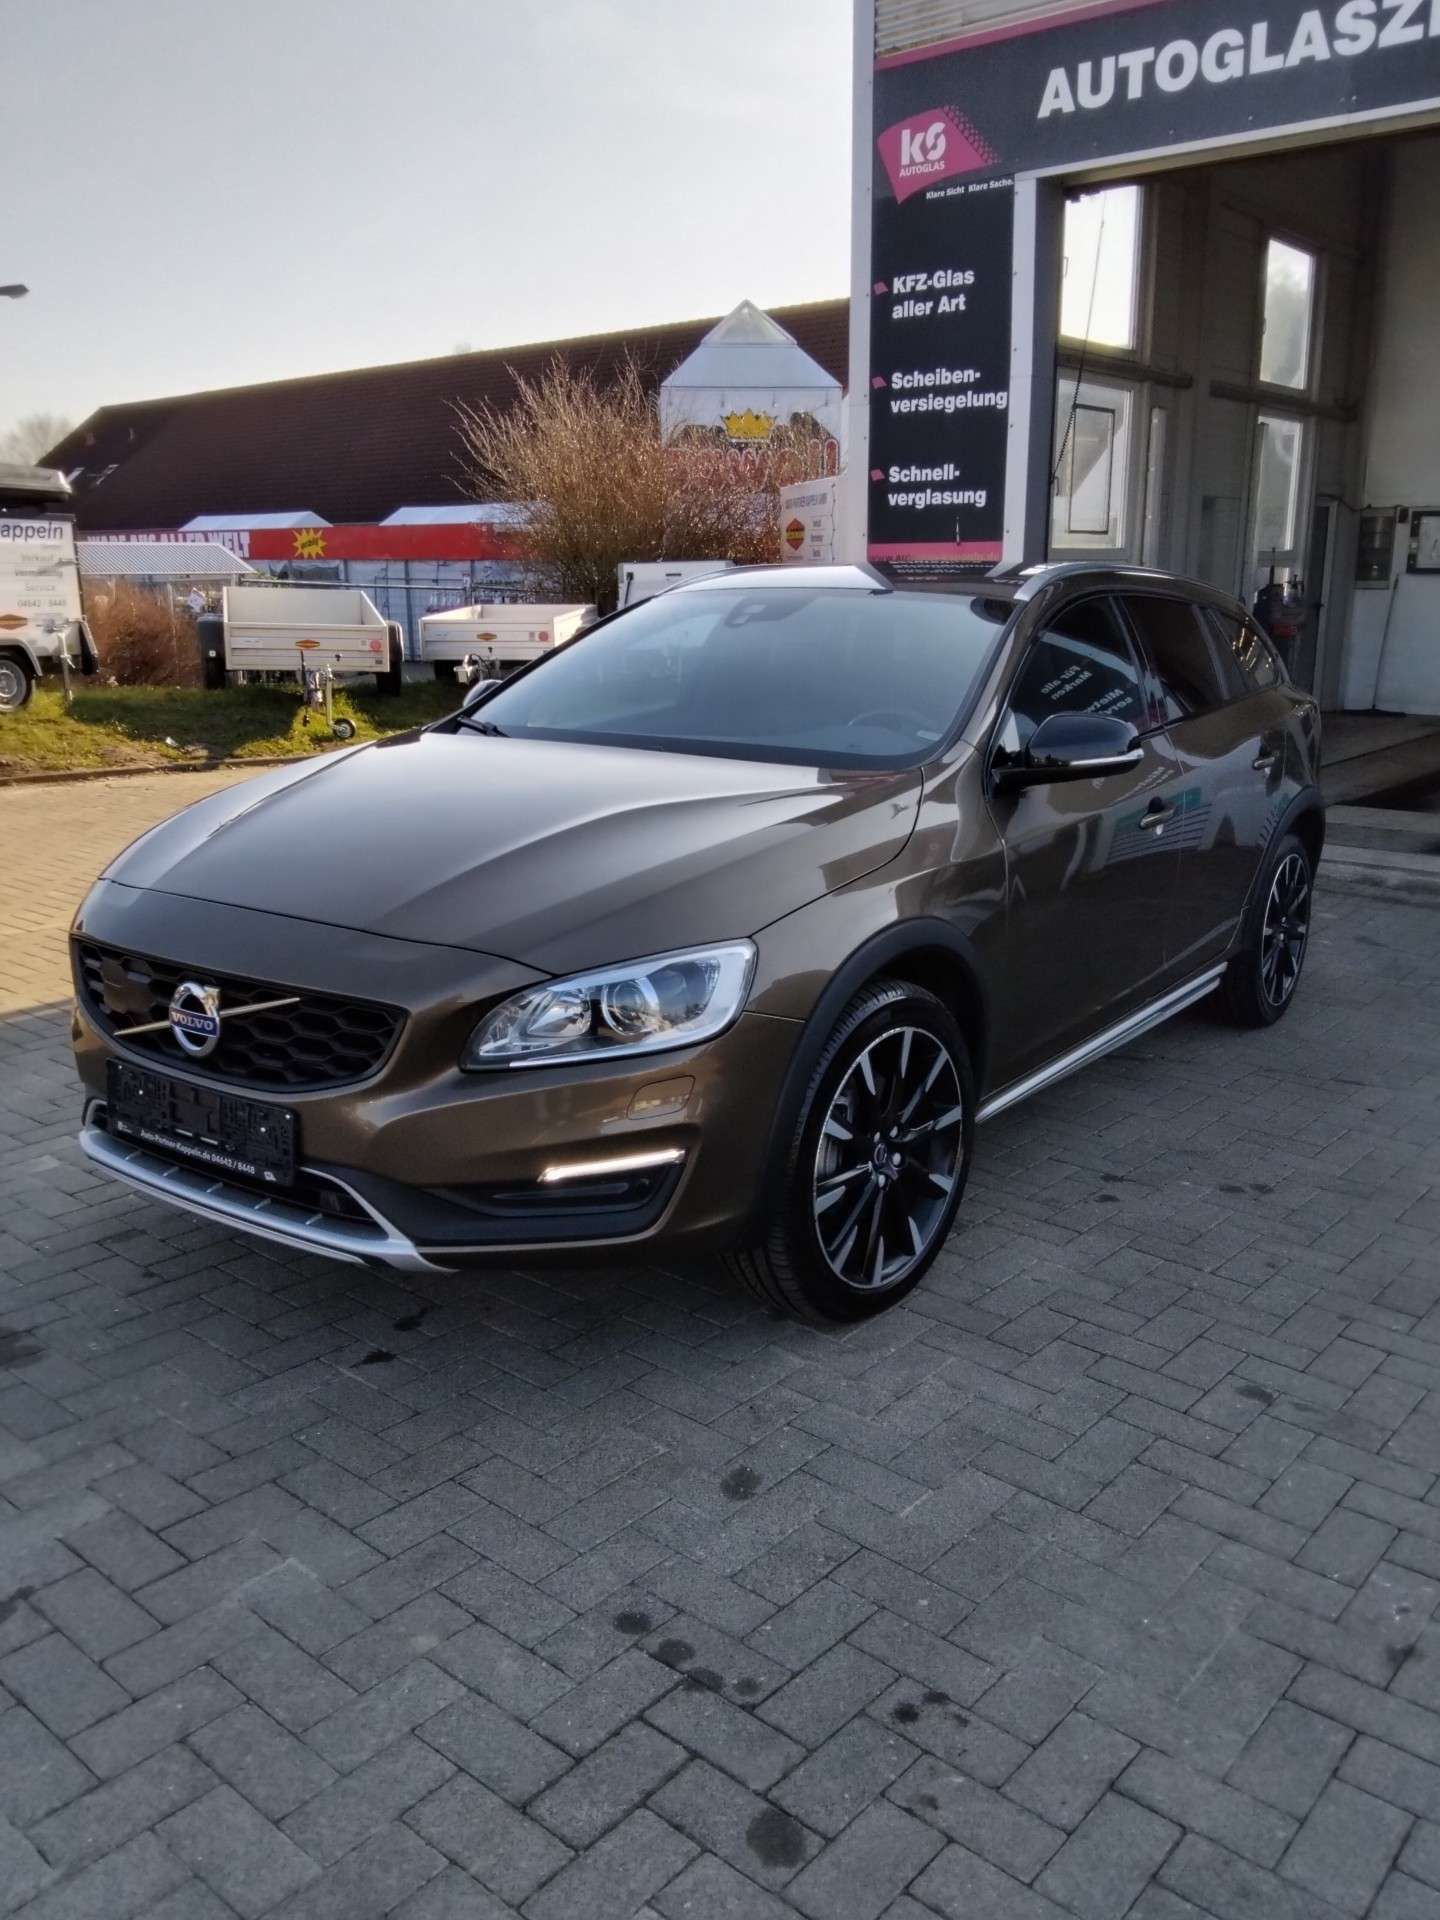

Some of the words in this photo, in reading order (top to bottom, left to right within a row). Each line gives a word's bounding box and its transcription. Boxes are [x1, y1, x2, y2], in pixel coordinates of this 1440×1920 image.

[899, 160, 945, 177] AUTOGLAS
[926, 190, 946, 199] Klare
[946, 185, 965, 196] Sicht
[968, 182, 988, 192] Klare
[892, 269, 975, 295] KFZ-Glas
[891, 300, 934, 319] aller
[937, 293, 966, 313] Art
[891, 367, 981, 390] Scheiben-
[890, 390, 1008, 413] versiegelung
[888, 463, 960, 483] Schnell-
[887, 488, 987, 509] verglasung
[170, 1011, 214, 1031] VOLVO
